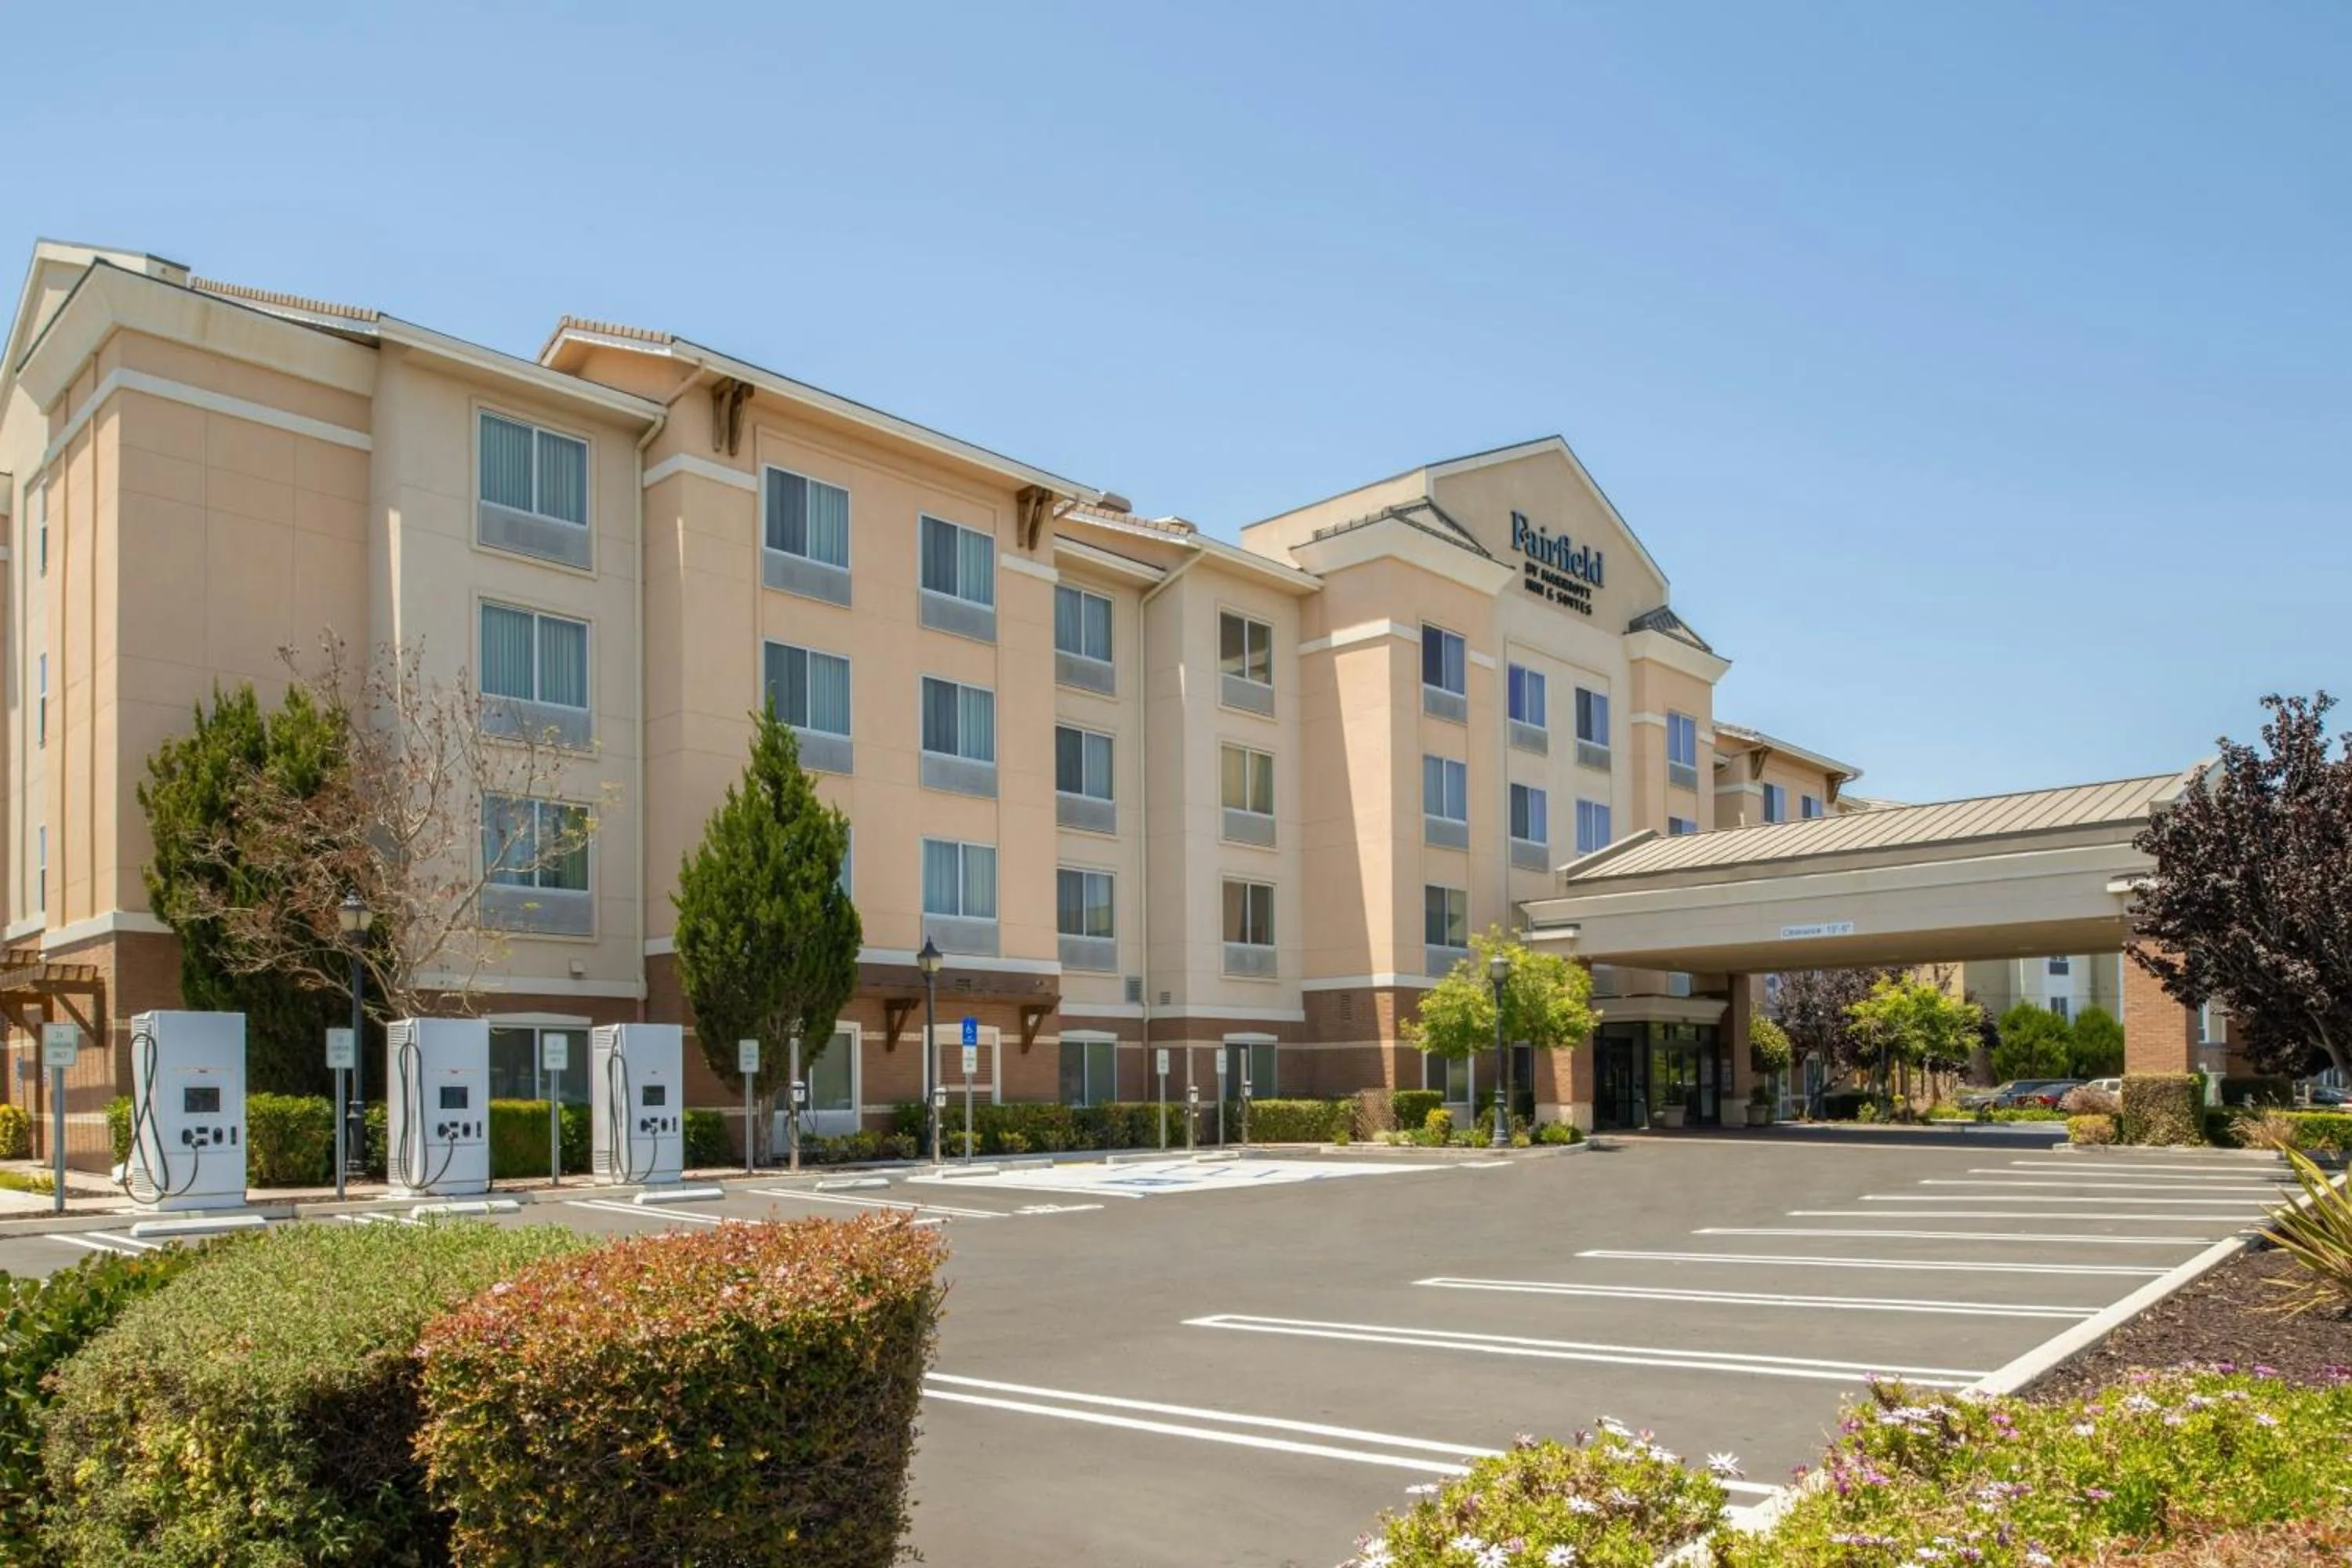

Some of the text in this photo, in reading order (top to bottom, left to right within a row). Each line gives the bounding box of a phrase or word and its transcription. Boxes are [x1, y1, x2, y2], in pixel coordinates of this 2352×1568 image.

[1510, 510, 1605, 589] Fairfield
[1525, 578, 1592, 615] INN & SUITES
